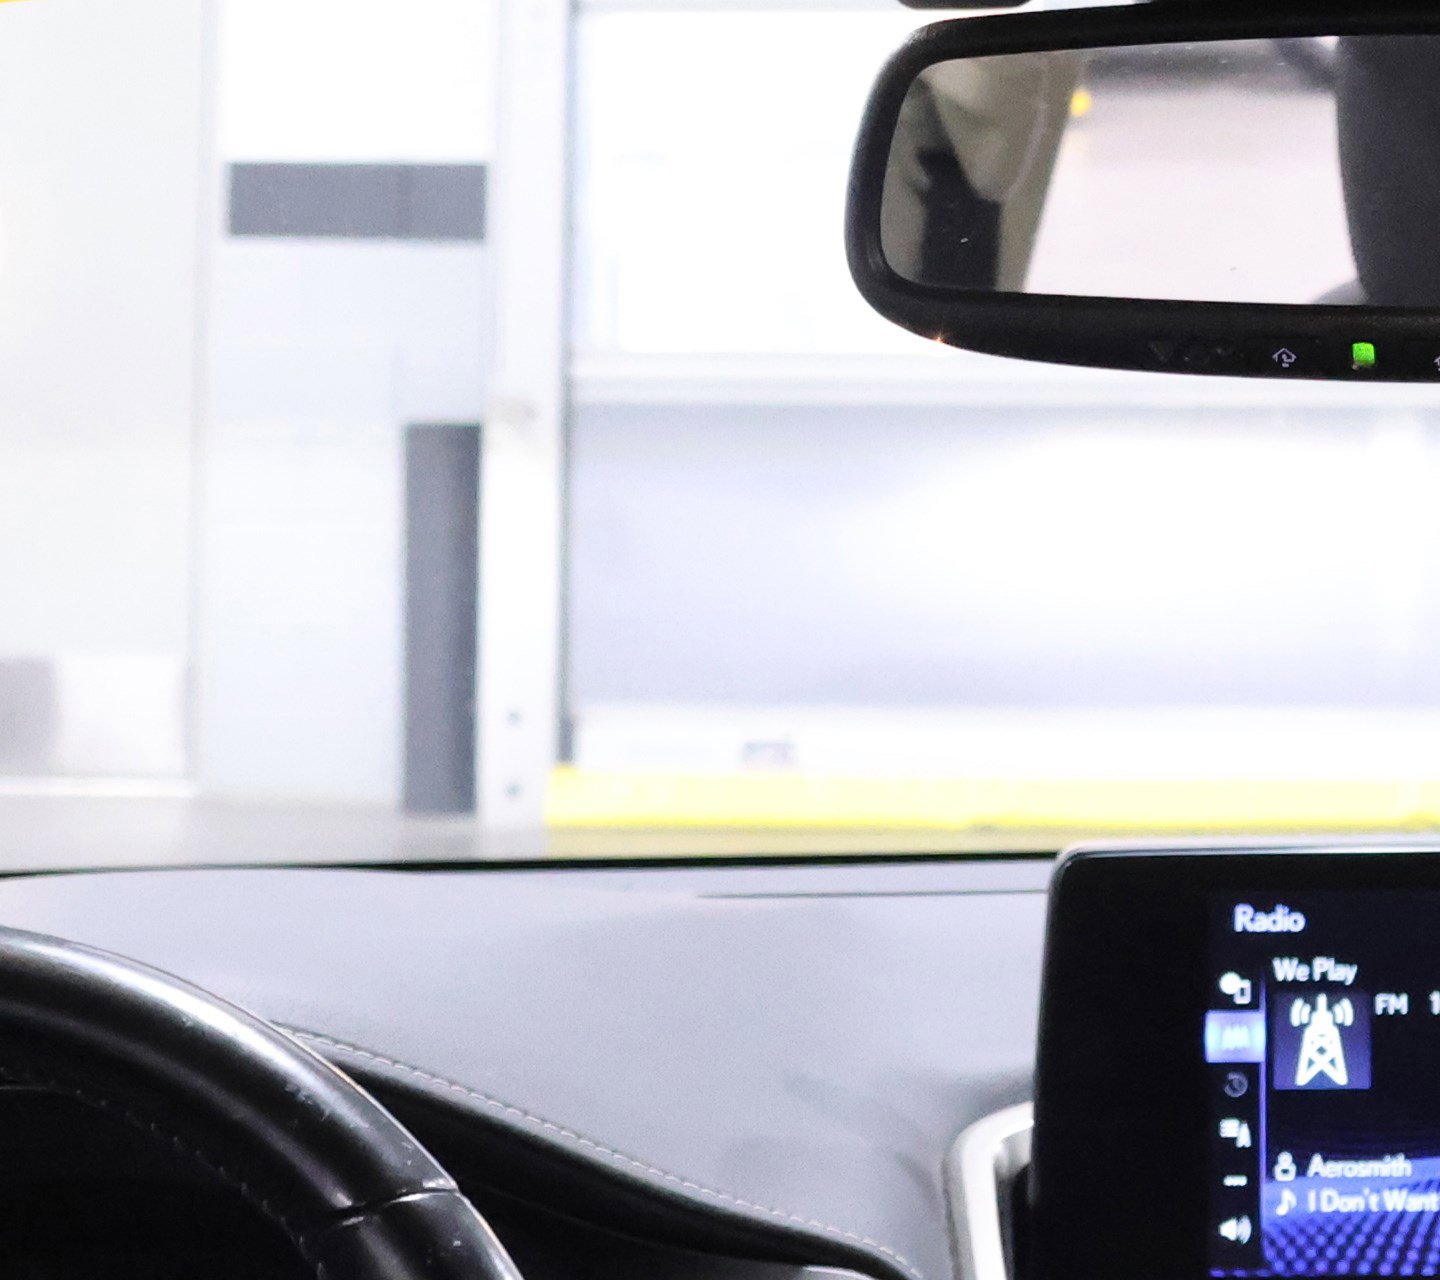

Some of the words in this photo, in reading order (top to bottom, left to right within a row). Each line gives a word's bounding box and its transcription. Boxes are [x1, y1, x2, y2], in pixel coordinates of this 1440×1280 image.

[1233, 903, 1306, 933] Radio
[1272, 956, 1311, 982] We
[1312, 956, 1358, 986] Play
[1374, 991, 1409, 1016] FM
[1307, 1152, 1413, 1178] Aerosmith
[1307, 1188, 1317, 1212] I
[1320, 1187, 1379, 1213] Don't
[1381, 1188, 1440, 1213] Want
